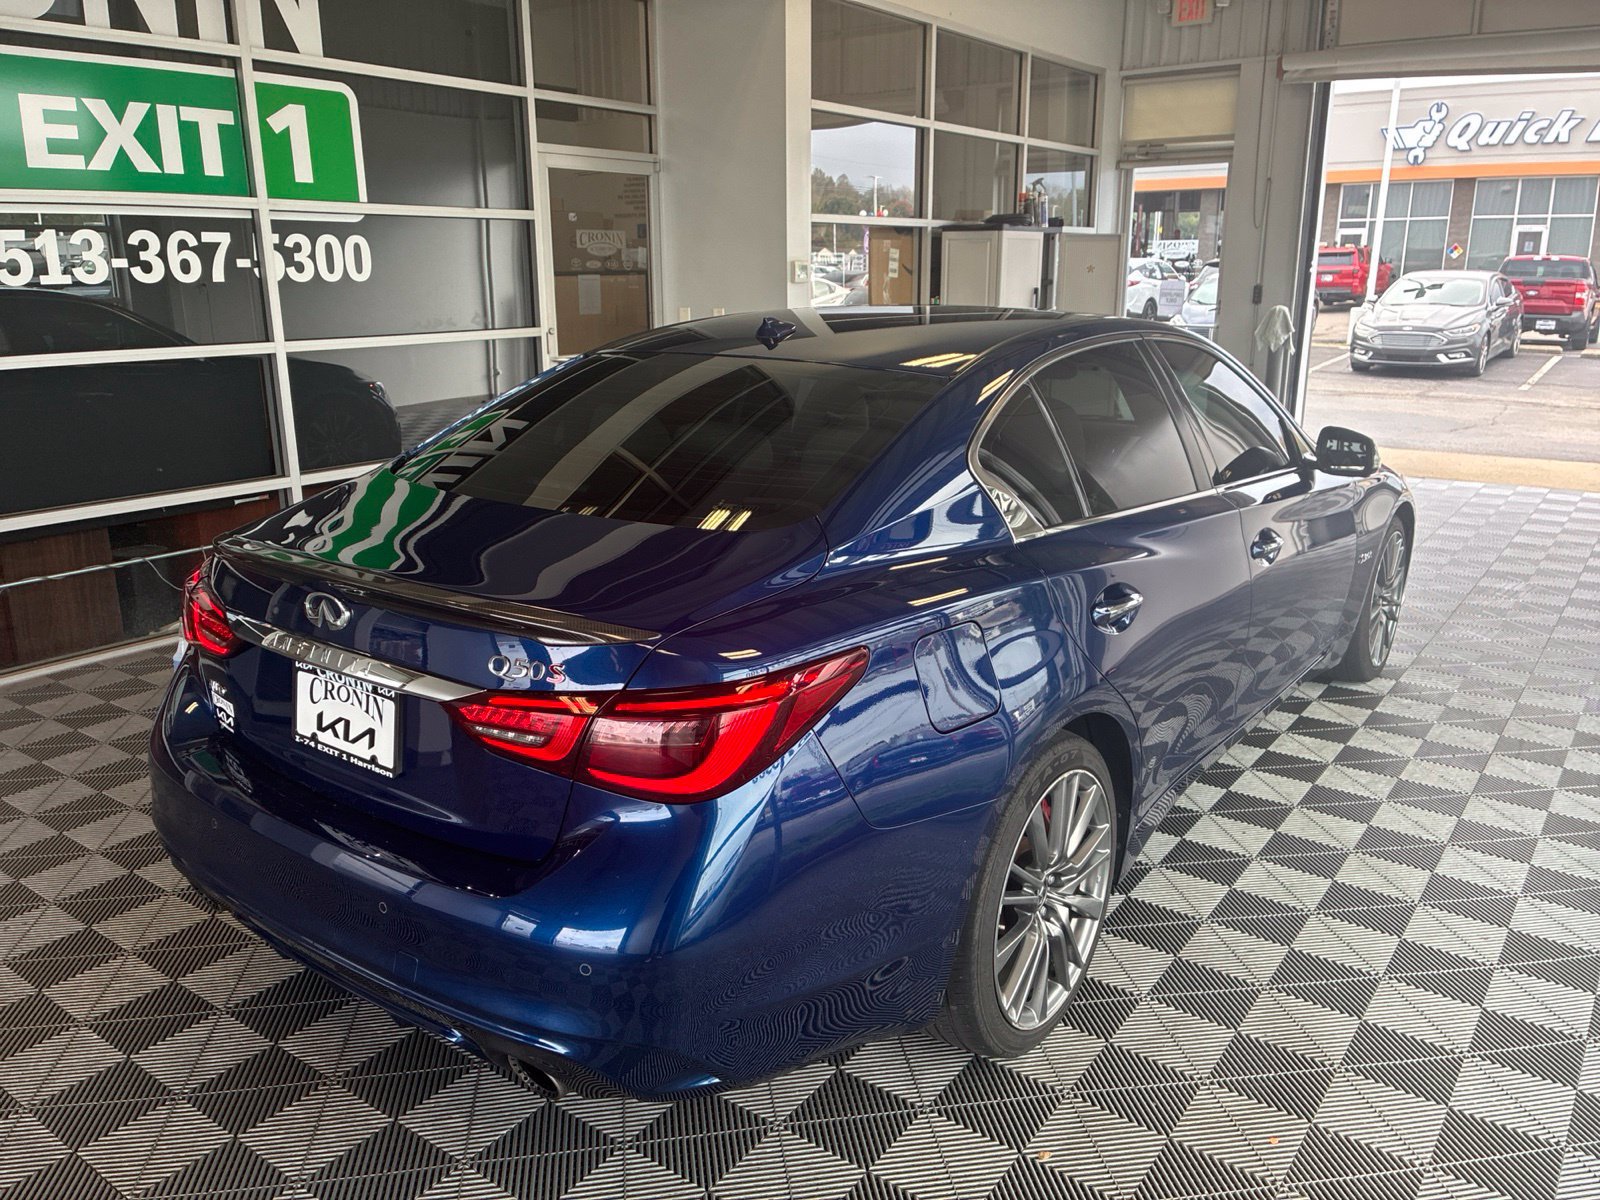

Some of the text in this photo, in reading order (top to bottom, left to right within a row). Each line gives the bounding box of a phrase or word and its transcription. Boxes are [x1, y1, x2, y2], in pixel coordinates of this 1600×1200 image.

[18, 93, 314, 184] EXIT 1
[1446, 109, 1585, 151] Quick
[580, 231, 623, 247] CRONIN
[317, 667, 372, 693] CRONIN
[309, 677, 386, 728] CRONIN
[294, 735, 393, 778] I-74 EXIT 1 Harrison
